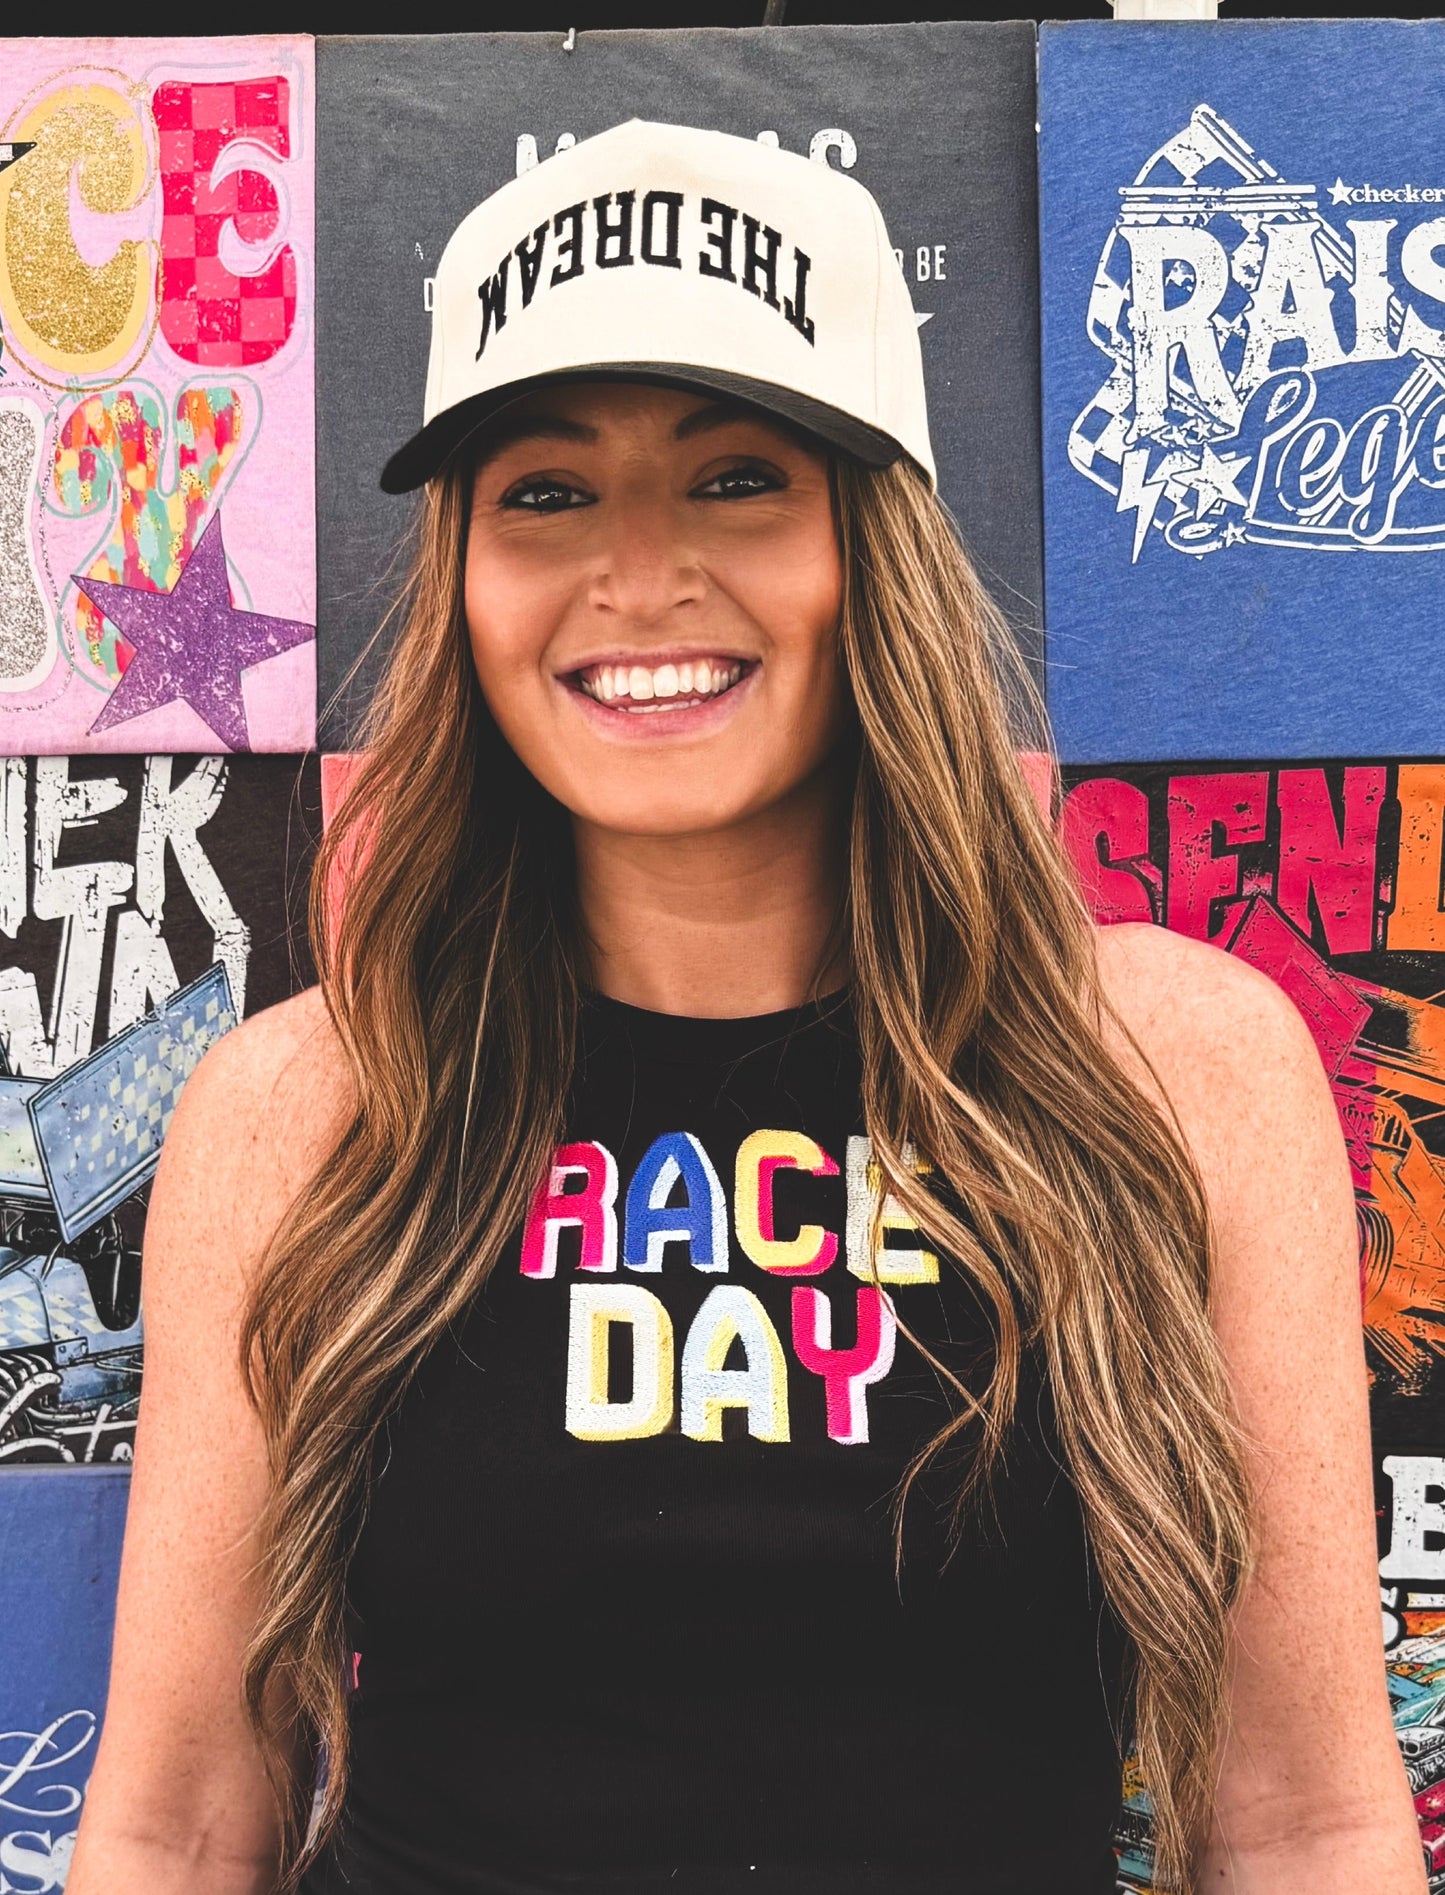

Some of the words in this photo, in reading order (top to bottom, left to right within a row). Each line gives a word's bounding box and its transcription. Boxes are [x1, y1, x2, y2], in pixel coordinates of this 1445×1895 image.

[474, 188, 685, 362] DREAM
[699, 196, 815, 347] THE
[916, 244, 947, 282] BE
[518, 1128, 941, 1285] RACE
[564, 1282, 898, 1445] DAY
